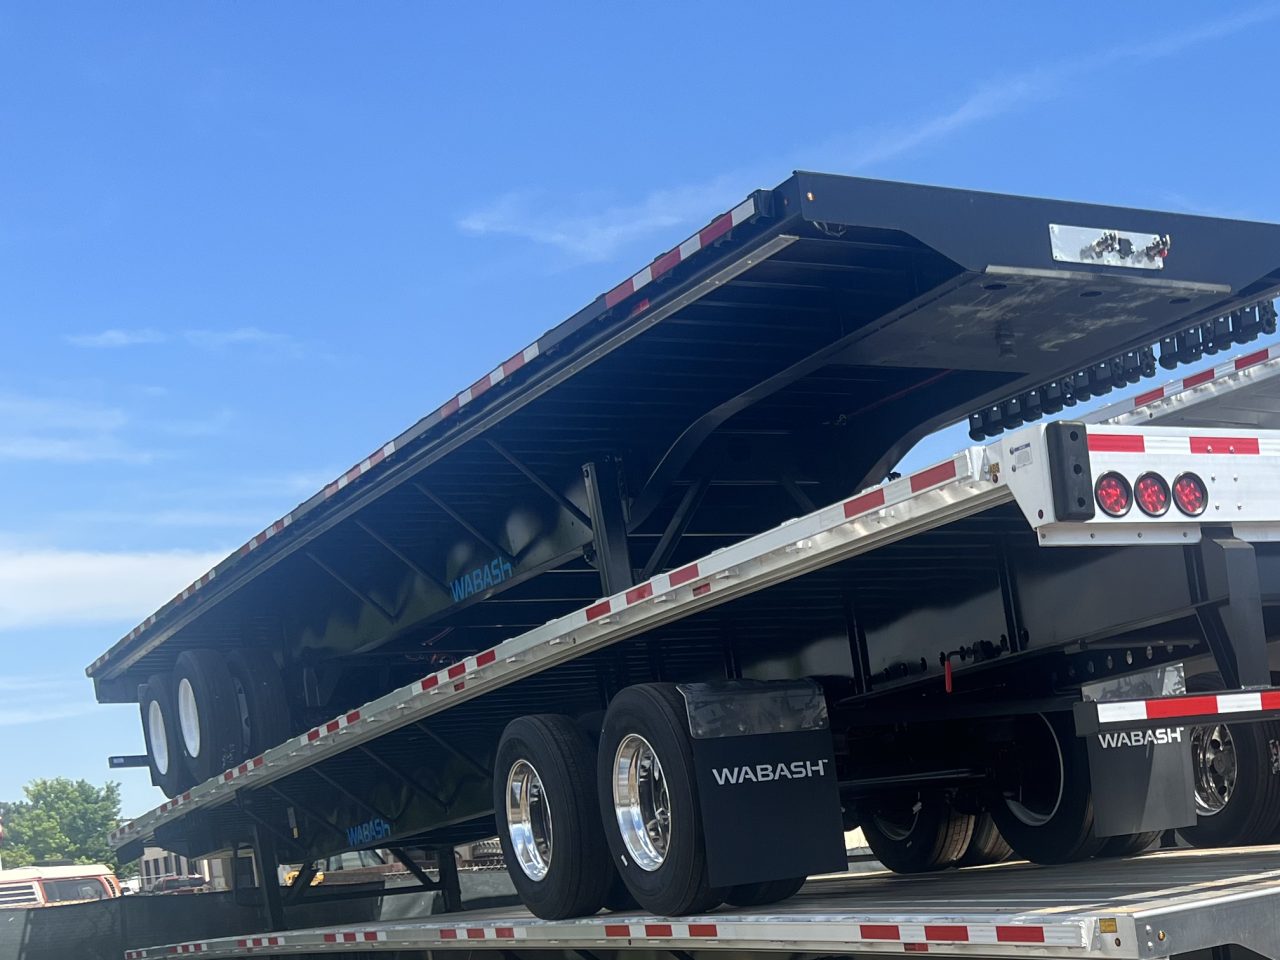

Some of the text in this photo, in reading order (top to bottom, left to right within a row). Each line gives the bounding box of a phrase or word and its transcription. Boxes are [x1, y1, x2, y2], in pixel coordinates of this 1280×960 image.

[450, 556, 513, 602] WABASH
[1098, 727, 1184, 749] WABASH
[711, 760, 828, 785] WABASH
[346, 818, 391, 847] WABASH
